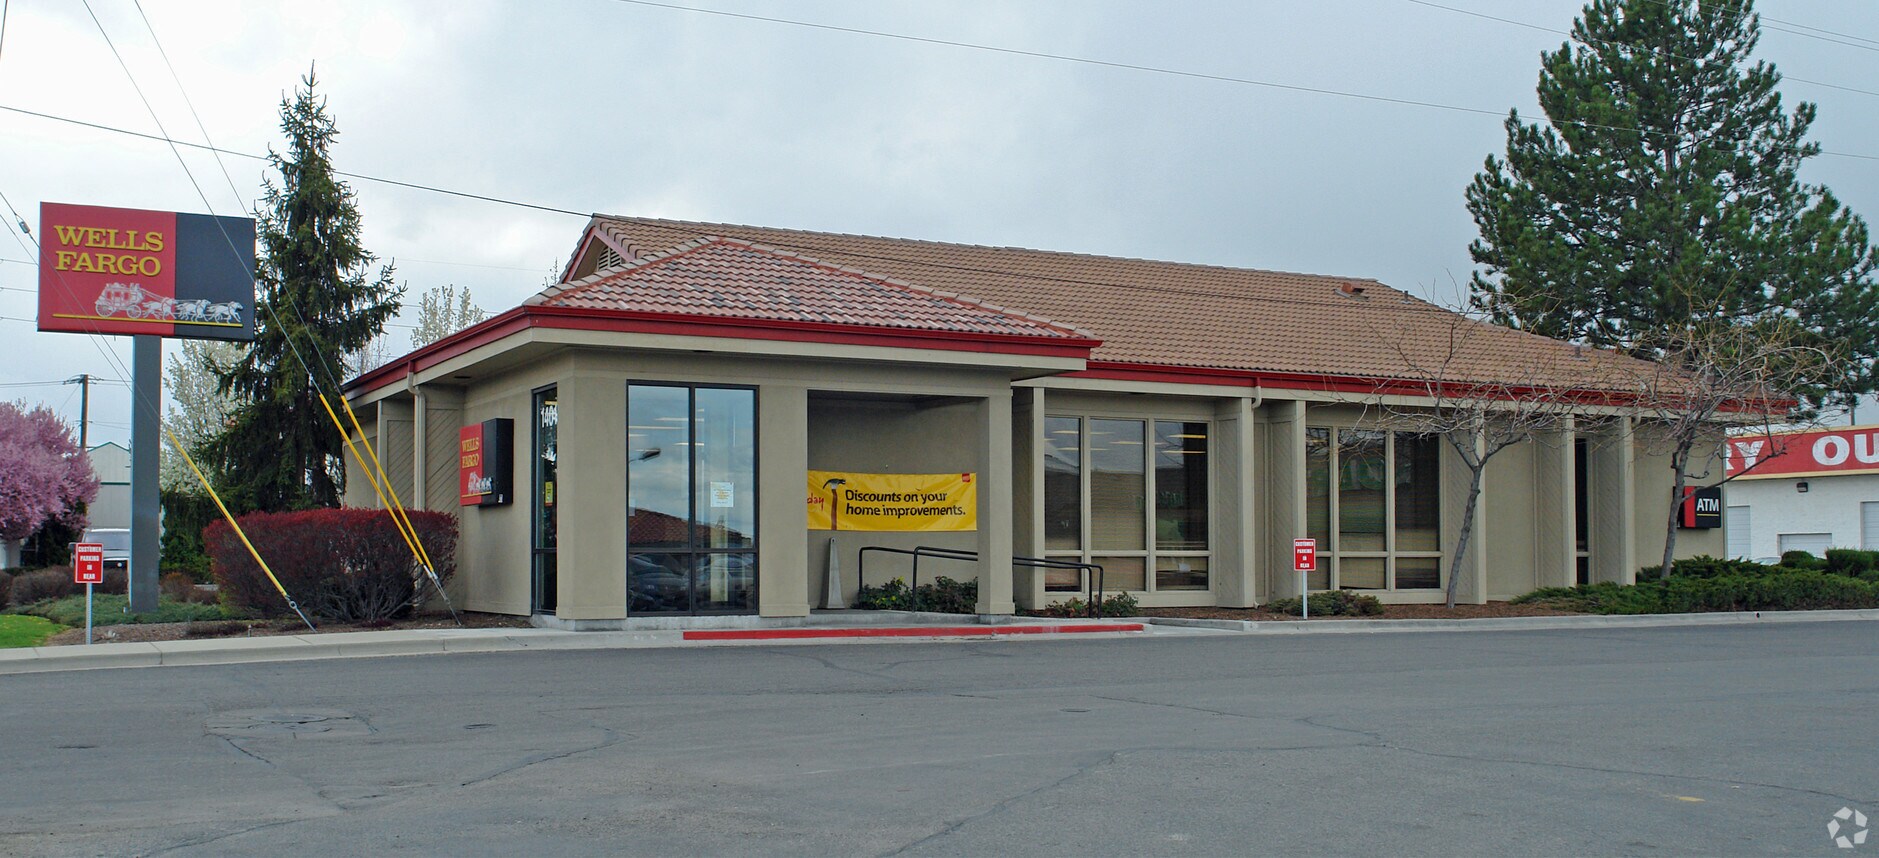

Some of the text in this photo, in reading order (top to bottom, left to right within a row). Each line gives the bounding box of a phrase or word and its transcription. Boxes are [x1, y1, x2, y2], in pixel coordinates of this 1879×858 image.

[53, 225, 164, 251] WELLS
[55, 250, 162, 276] FARGO
[462, 437, 480, 452] WELLS
[462, 454, 480, 468] FARGO
[1726, 440, 1765, 470] Y
[845, 489, 948, 505] Discounts on your
[1696, 498, 1720, 512] ATM
[845, 503, 967, 519] home improvements.
